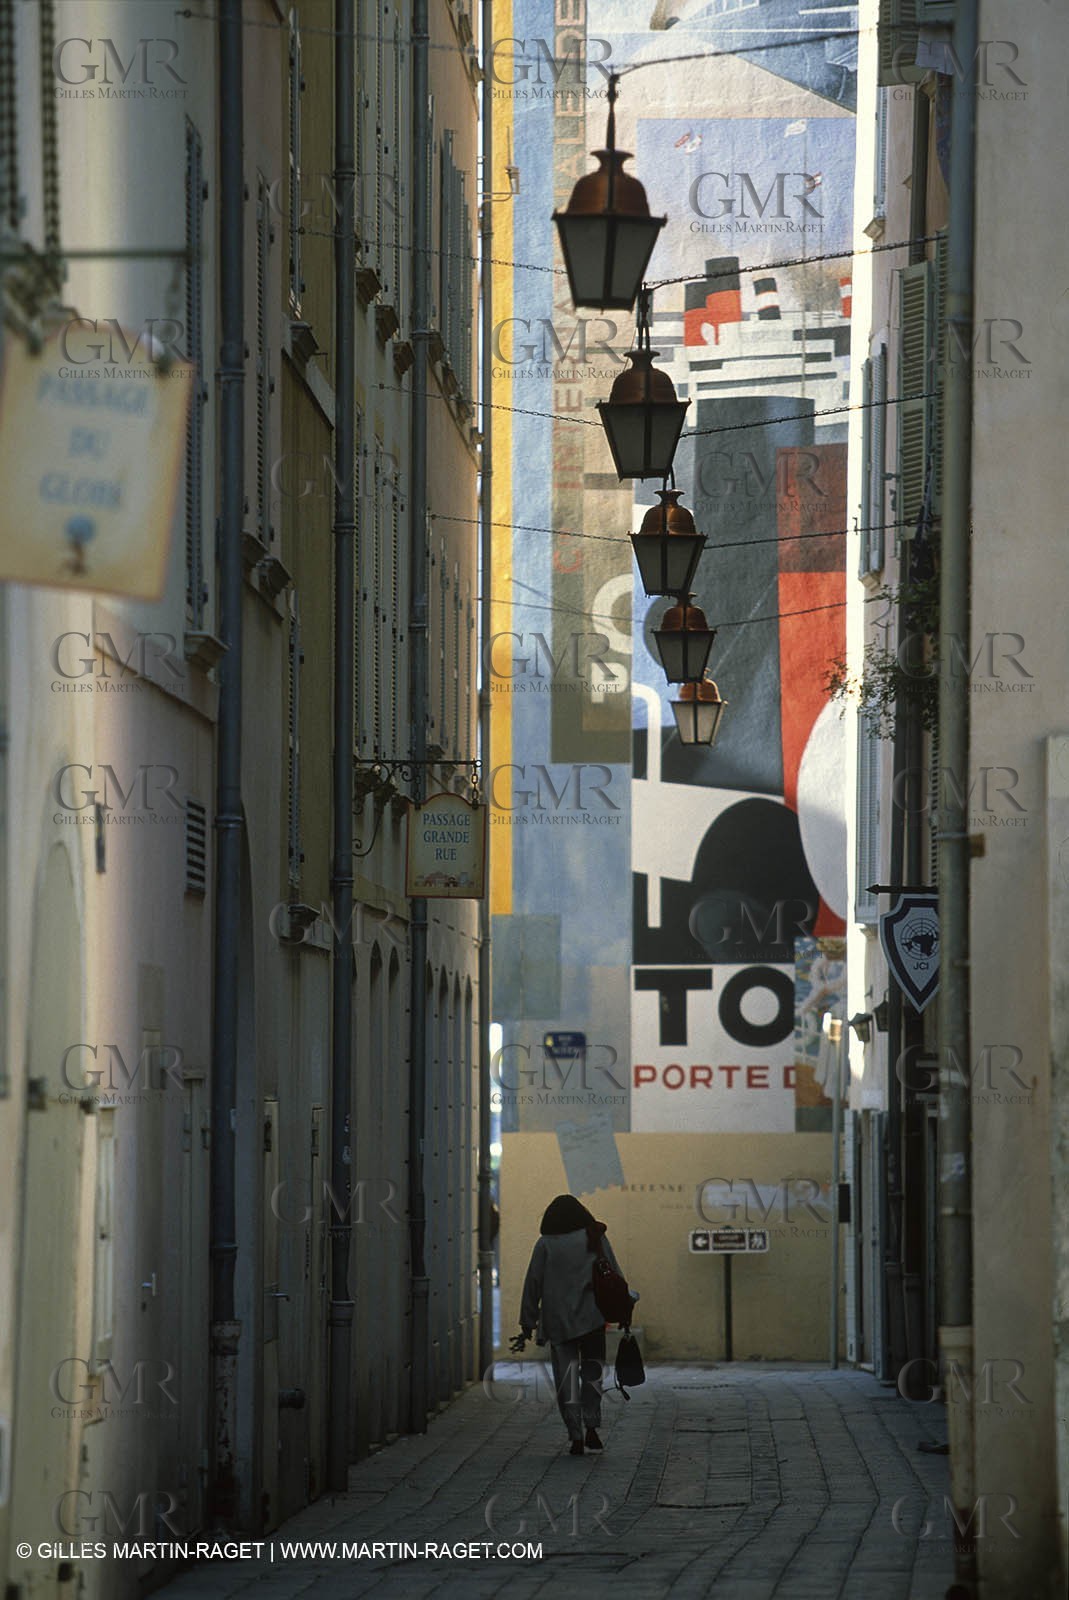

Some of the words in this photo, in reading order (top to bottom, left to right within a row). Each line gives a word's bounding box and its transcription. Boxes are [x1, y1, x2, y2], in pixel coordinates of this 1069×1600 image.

[423, 812, 470, 826] PASSAGE
[423, 830, 469, 844] GRANDE
[435, 848, 457, 861] RUE
[913, 962, 929, 971] JCI
[634, 965, 796, 1047] TO
[634, 1064, 769, 1090] PORTE
